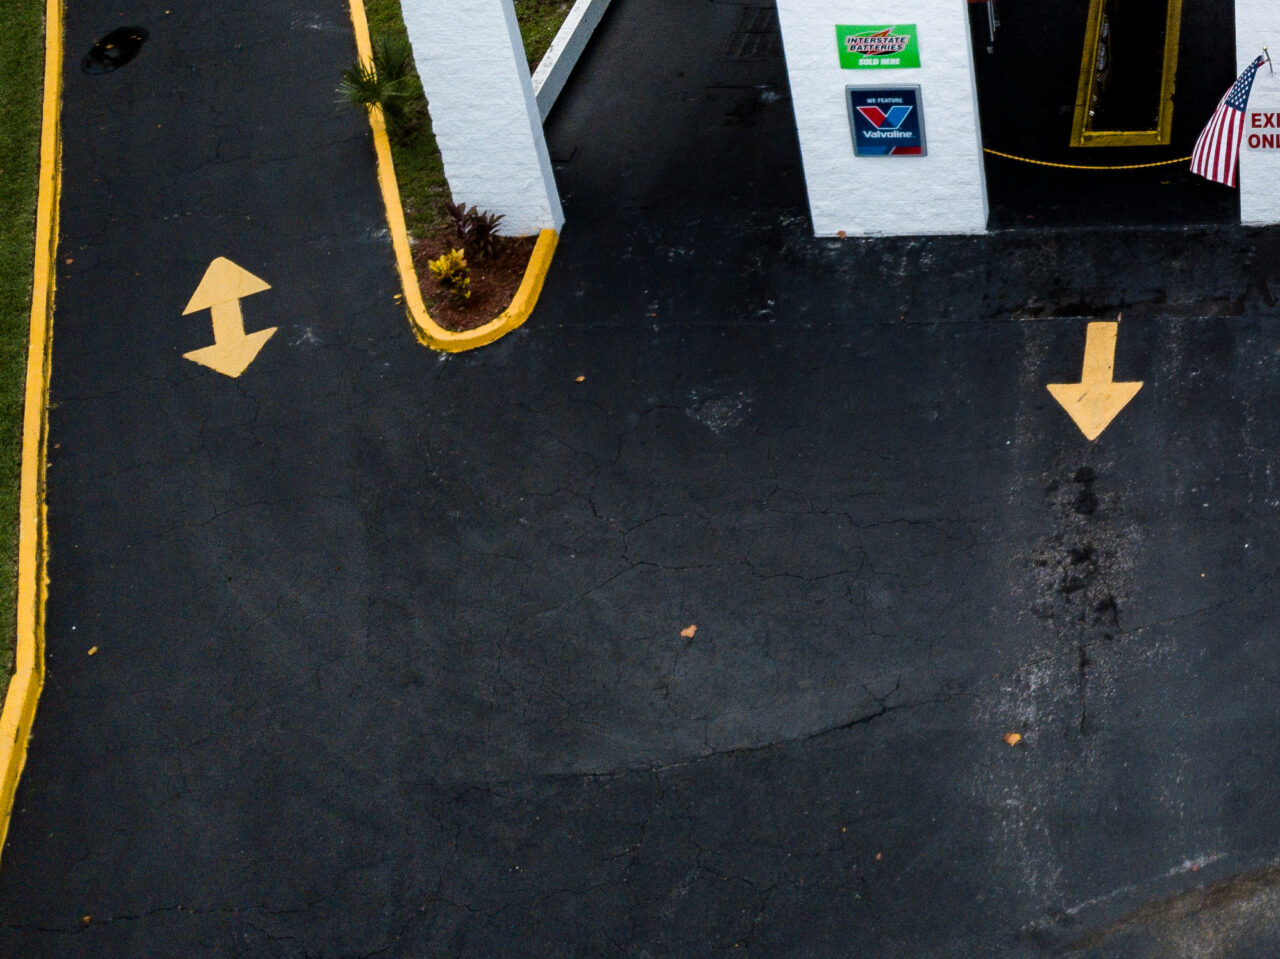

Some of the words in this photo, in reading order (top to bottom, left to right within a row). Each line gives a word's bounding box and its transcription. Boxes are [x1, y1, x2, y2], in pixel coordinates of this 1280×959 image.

[847, 36, 907, 44] INTERSTATE
[850, 43, 903, 51] BATTERIES
[863, 130, 912, 138] Valvoline
